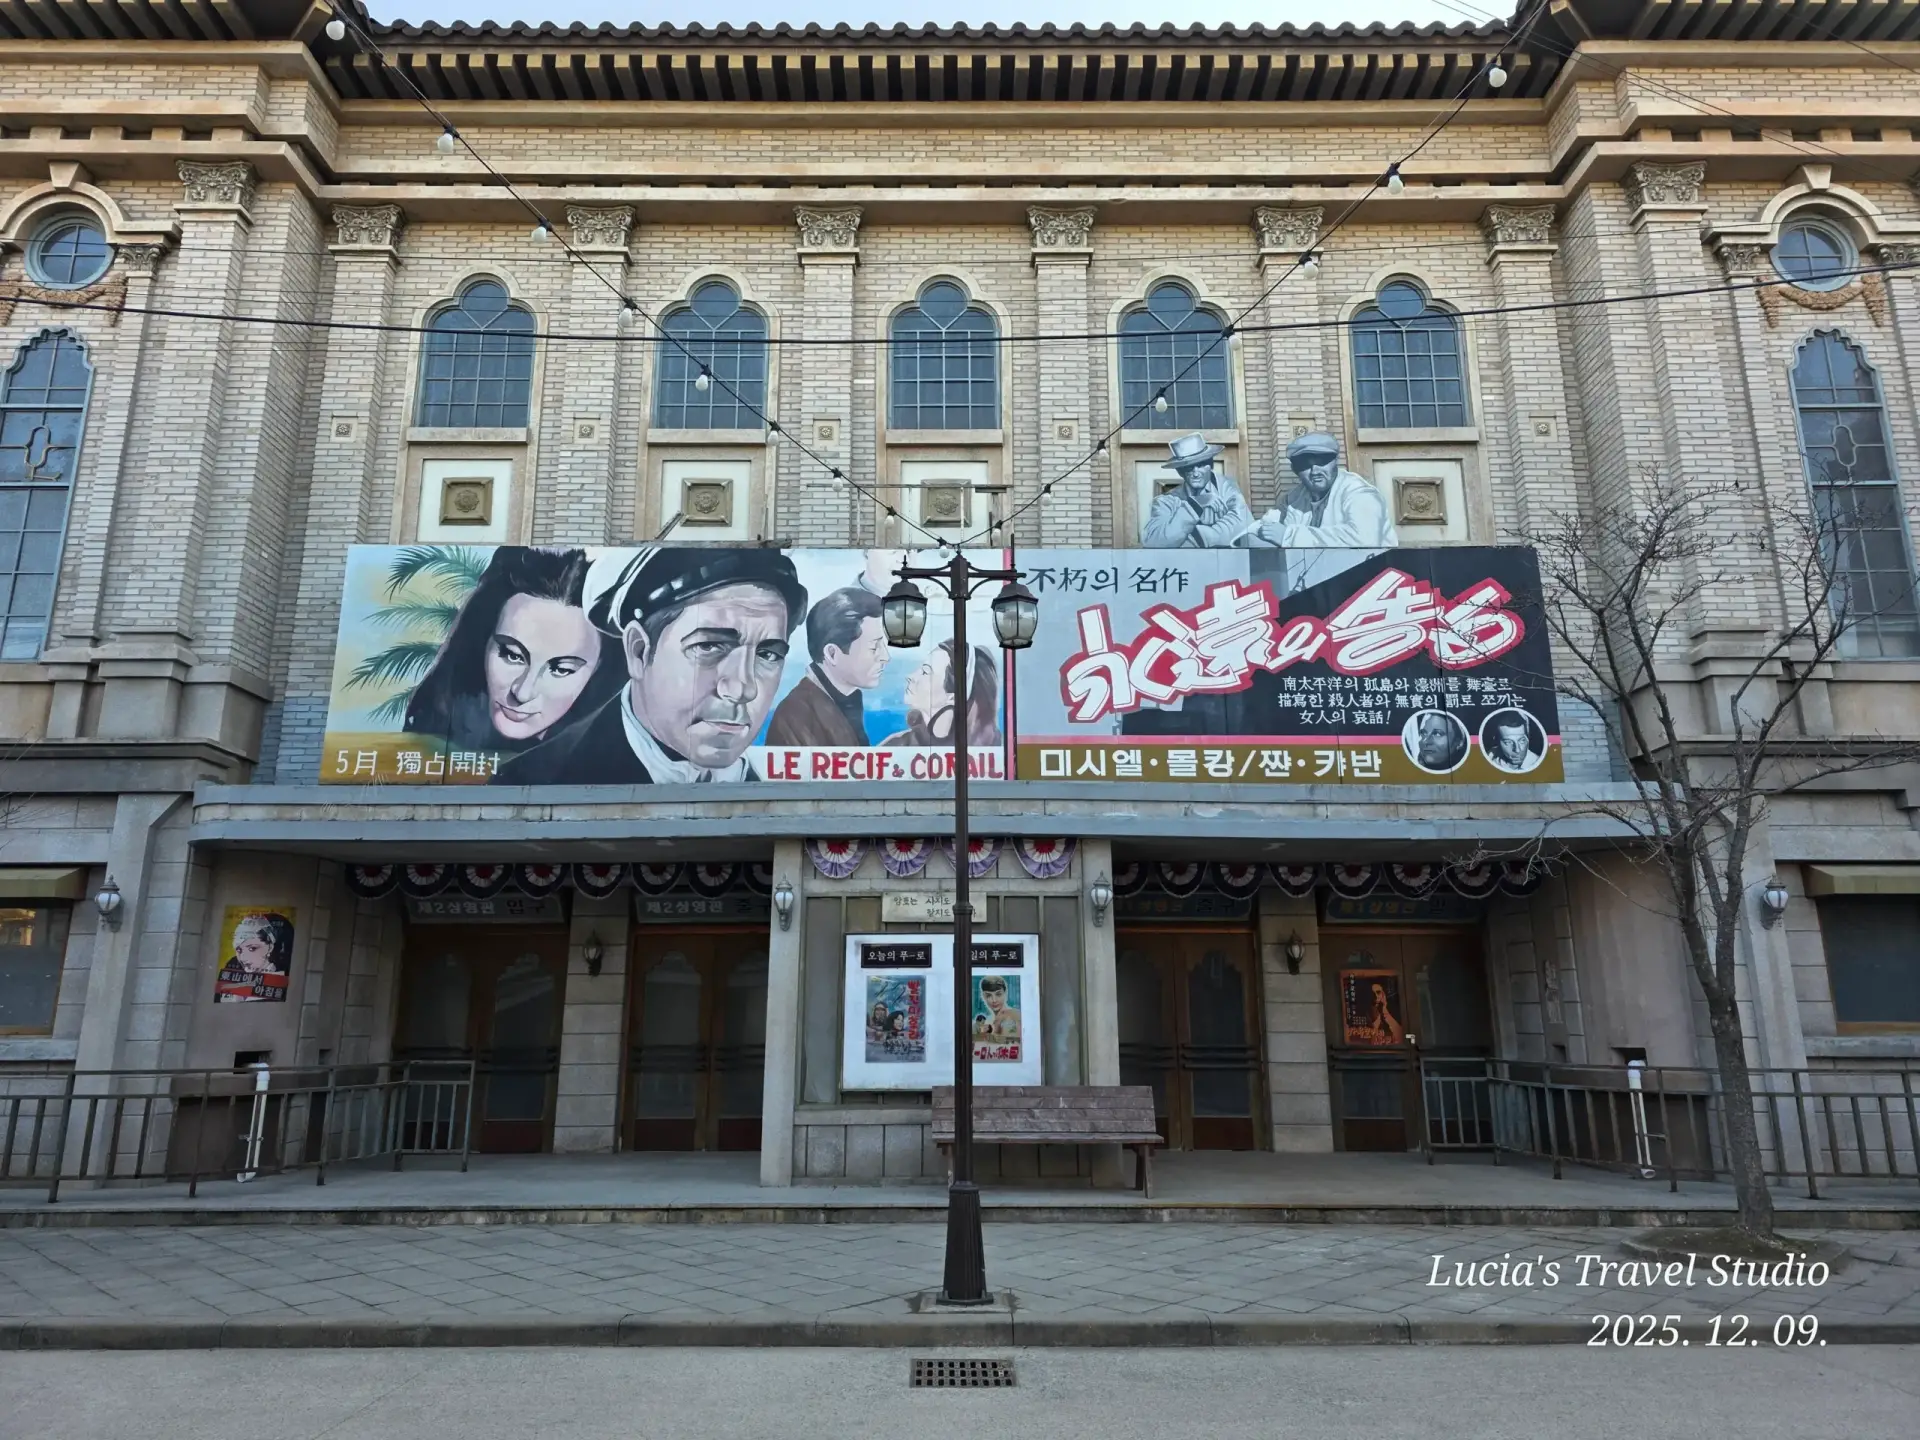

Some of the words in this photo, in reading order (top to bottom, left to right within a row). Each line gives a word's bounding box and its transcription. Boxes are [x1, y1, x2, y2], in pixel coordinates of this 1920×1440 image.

[1025, 566, 1118, 594] 不朽의
[1127, 566, 1189, 594] 名作
[1281, 675, 1359, 692] 南太平洋의
[1363, 676, 1410, 692] 孤島와
[1298, 709, 1346, 725] 女人의
[335, 749, 379, 776] 5月
[396, 750, 501, 776] 獨占開封
[766, 751, 802, 780] LE
[811, 751, 894, 780] RECIF
[868, 949, 896, 962] 오늘의
